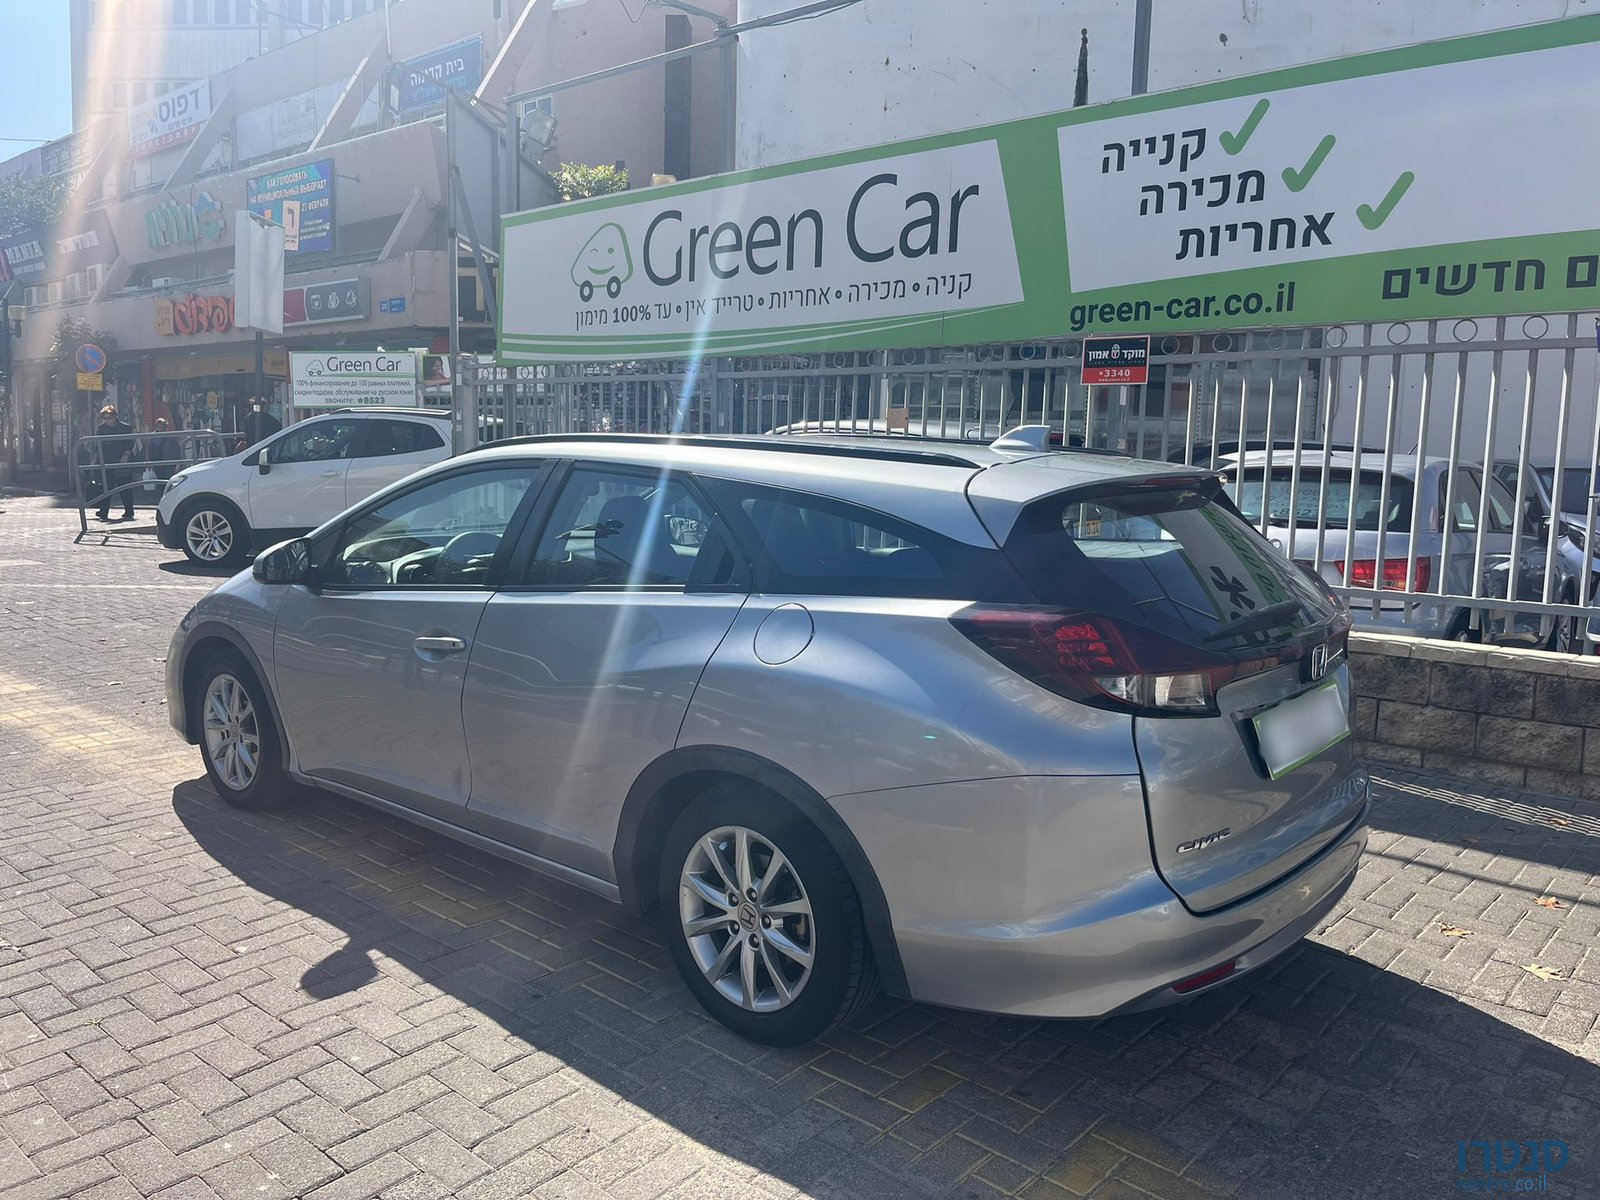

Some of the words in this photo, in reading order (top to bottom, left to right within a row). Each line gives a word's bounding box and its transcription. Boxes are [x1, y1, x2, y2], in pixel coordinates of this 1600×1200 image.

[445, 58, 464, 75] בית
[158, 87, 200, 123] דפוס
[1101, 128, 1207, 174] קנייה
[1139, 169, 1265, 216] מכירה
[643, 208, 824, 287] Green
[846, 173, 980, 263] Car
[1175, 211, 1336, 261] אחריות
[848, 279, 906, 303] מכירה
[926, 273, 972, 299] קניה
[1382, 258, 1546, 300] חדשים
[712, 294, 754, 315] טרייד
[768, 286, 831, 310] אחריות
[1069, 281, 1296, 332] green-car.co.il
[576, 308, 608, 332] מימון
[613, 304, 651, 324] 100%
[654, 302, 672, 320] עד
[685, 299, 706, 322] אין
[327, 356, 372, 372] Green
[376, 356, 401, 372] Car
[1088, 350, 1110, 362] אמון
[1122, 349, 1145, 360] מוקד
[296, 379, 309, 387] 100%
[310, 379, 351, 388] финансирование
[359, 379, 368, 387] 100
[1176, 827, 1231, 854] CIVIC
